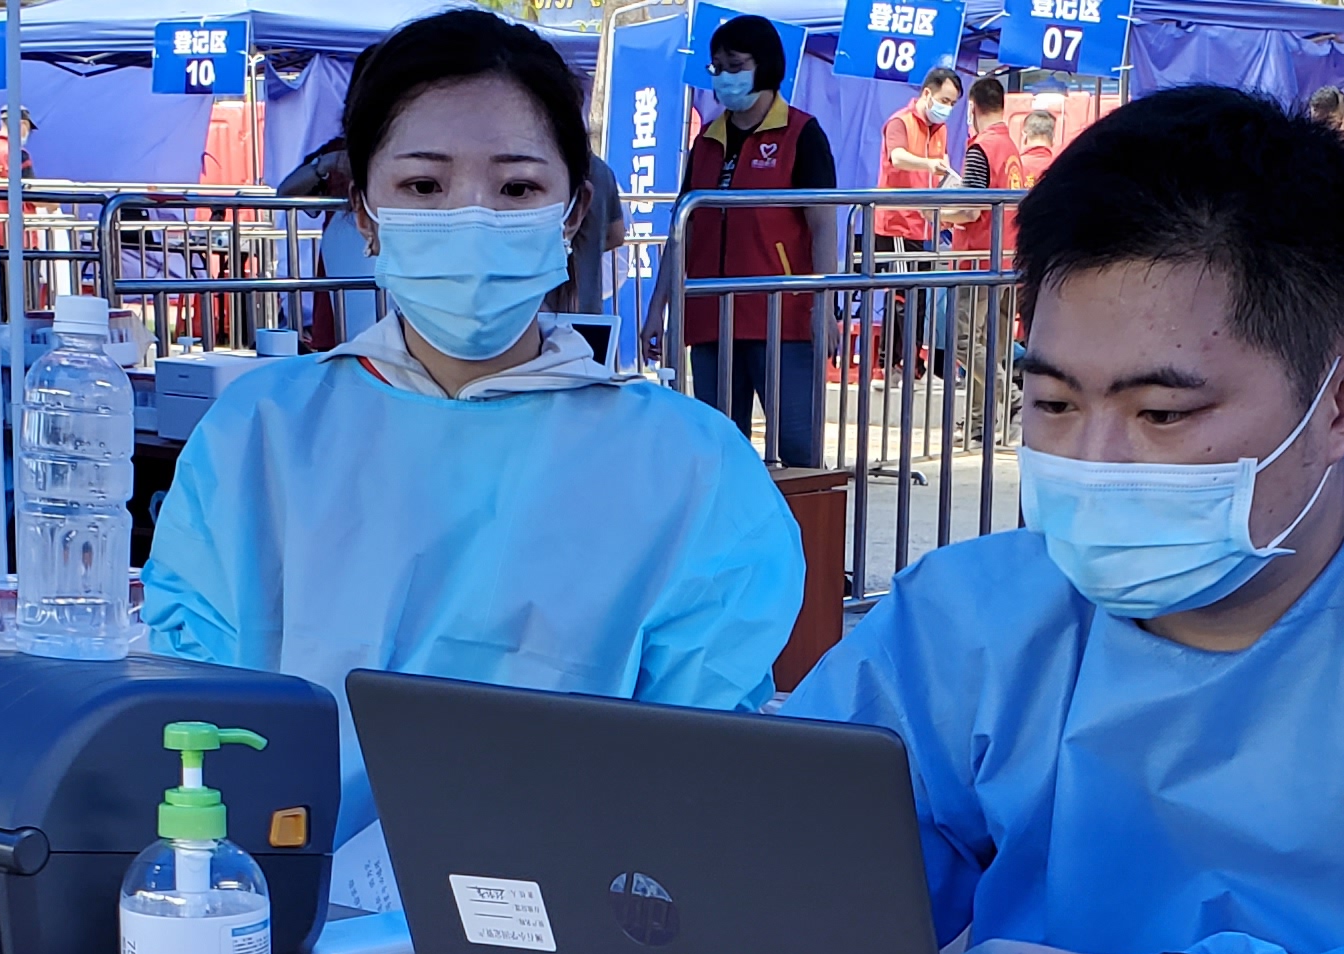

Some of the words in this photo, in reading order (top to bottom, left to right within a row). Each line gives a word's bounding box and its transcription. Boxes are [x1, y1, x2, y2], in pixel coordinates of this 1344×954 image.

[867, 3, 938, 36] 登记区
[173, 30, 228, 54] 登记区
[876, 37, 917, 72] 08
[1042, 27, 1083, 61] 07
[186, 59, 215, 86] 10
[627, 87, 658, 279] 登记区
